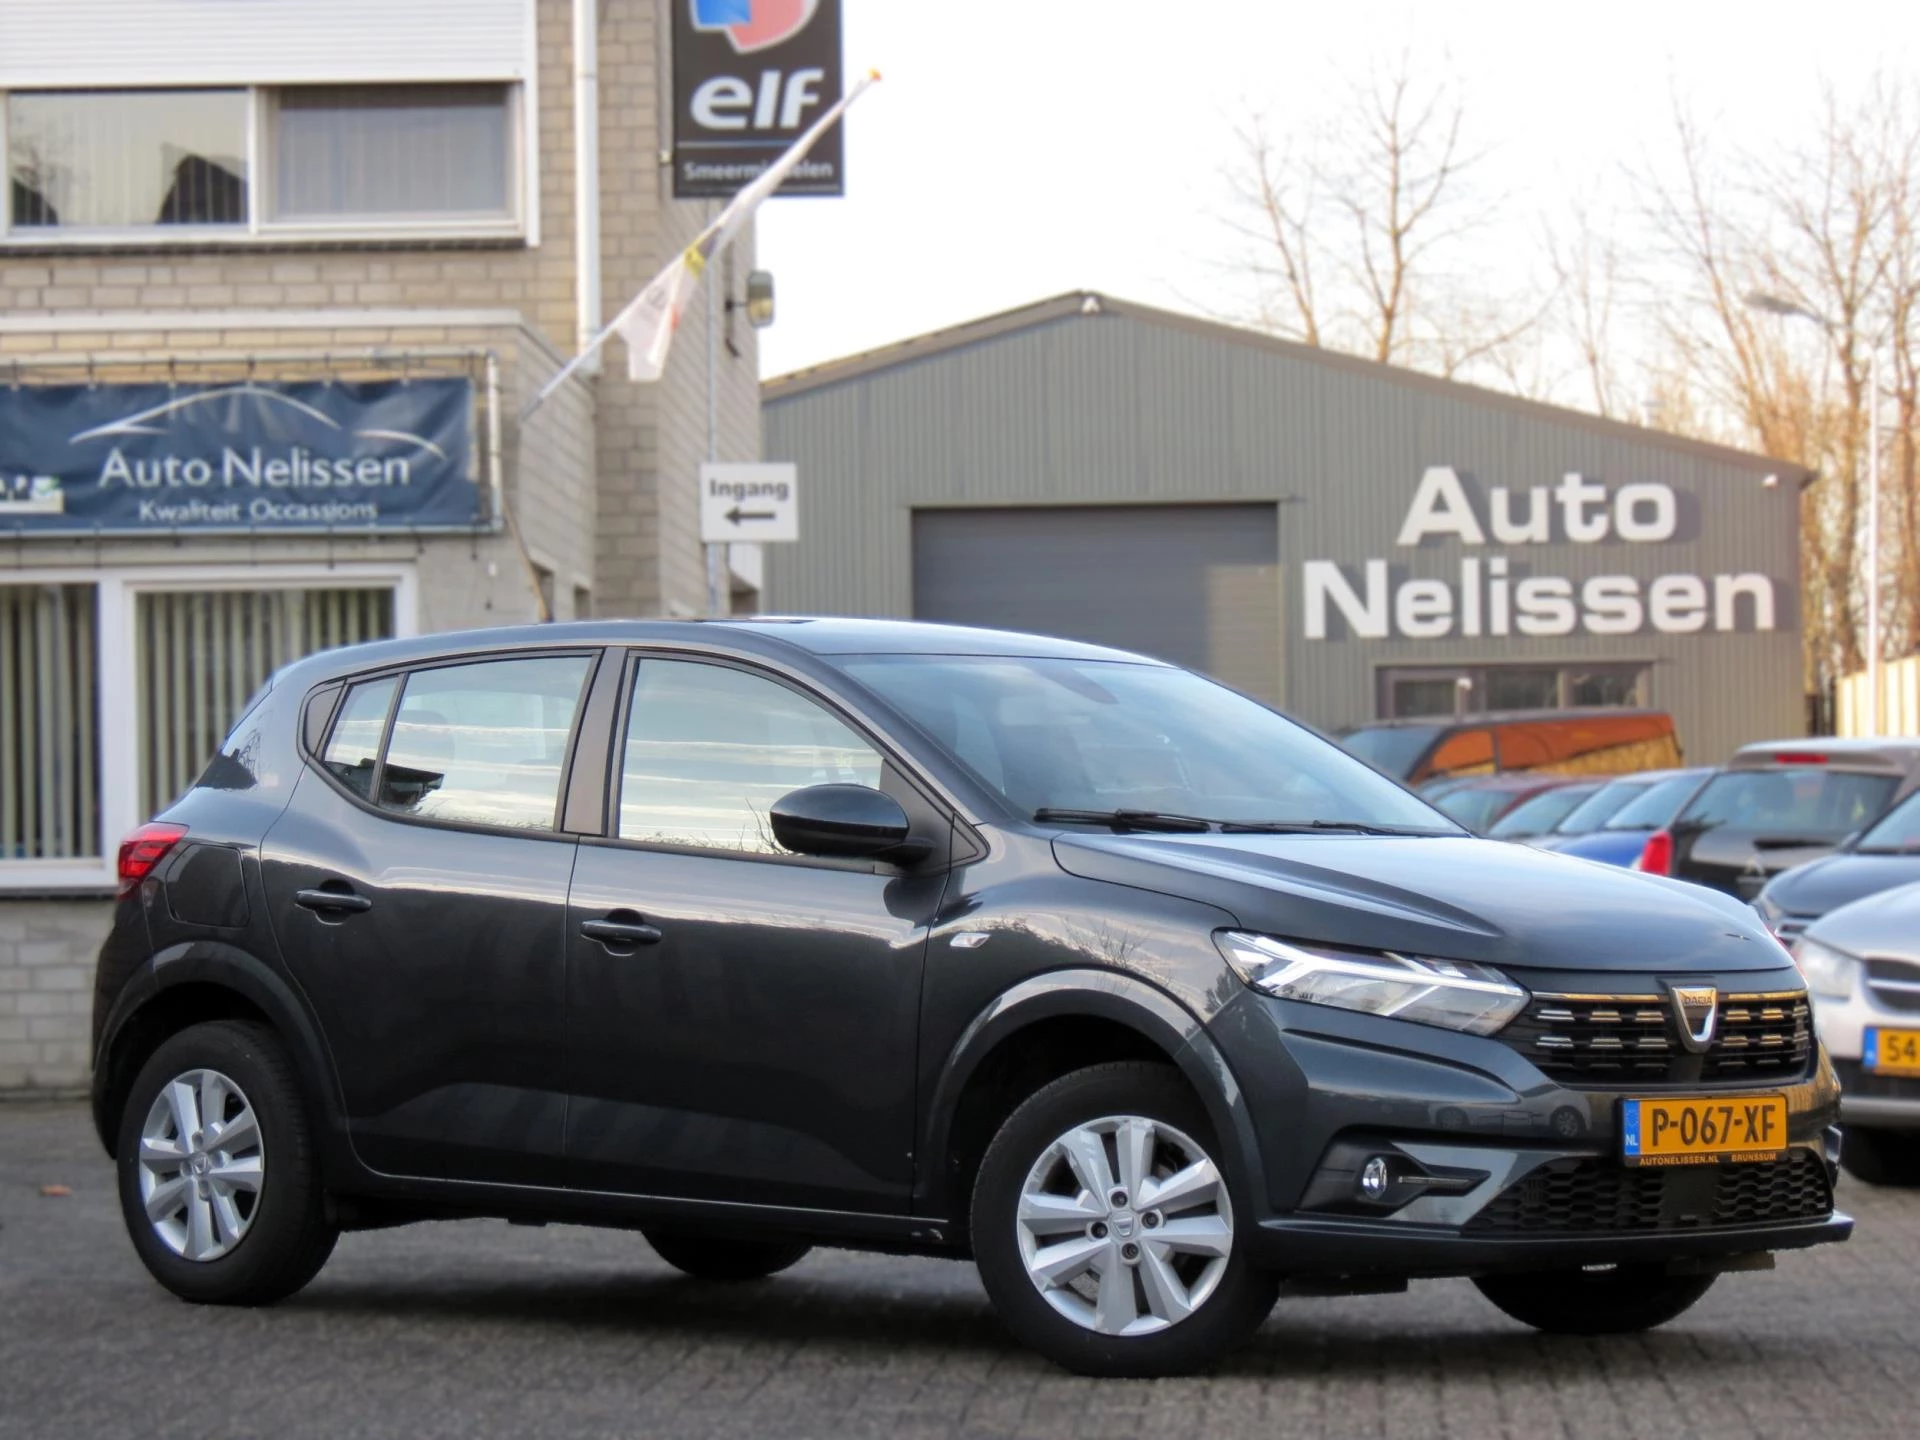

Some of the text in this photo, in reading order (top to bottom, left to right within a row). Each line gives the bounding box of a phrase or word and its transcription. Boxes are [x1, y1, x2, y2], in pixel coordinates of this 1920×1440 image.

[690, 67, 825, 130] elf
[683, 159, 833, 181] Smeermielen
[98, 446, 411, 488] Auto Nelissen
[709, 478, 789, 502] Ingang
[1396, 466, 1676, 546] Auto
[139, 498, 241, 521] Kwaliteit
[1303, 557, 1775, 640] Nelissen
[1625, 1133, 1638, 1146] NL
[1652, 1104, 1776, 1147] P-067-XF
[1640, 1152, 1777, 1166] AUTONELISSEN.NL BRUNSSUM
